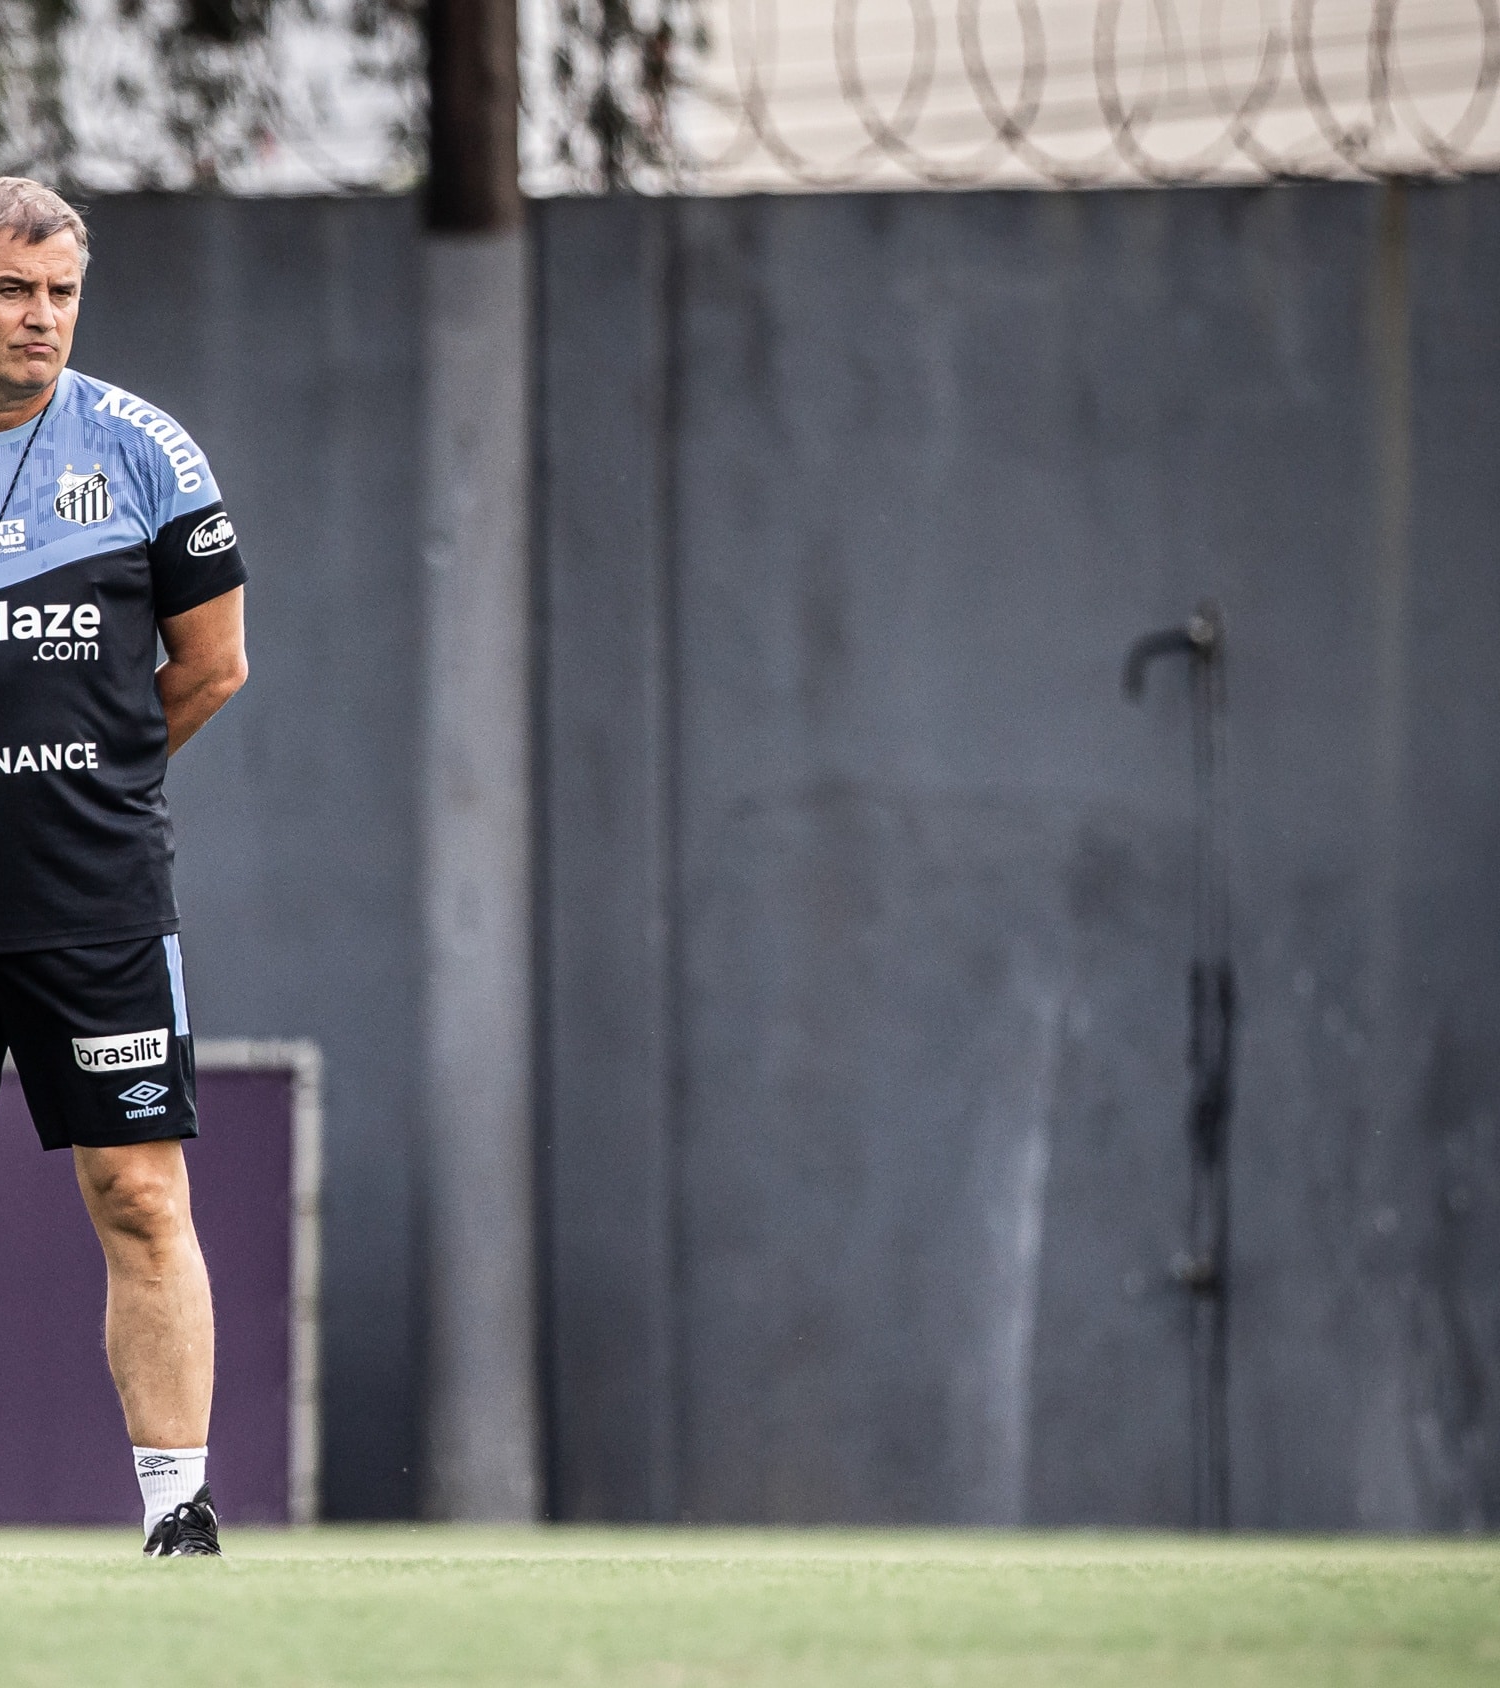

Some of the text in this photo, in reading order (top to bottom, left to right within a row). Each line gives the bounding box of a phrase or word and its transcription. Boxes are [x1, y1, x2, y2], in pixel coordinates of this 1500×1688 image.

[32, 641, 99, 661] .com
[76, 1037, 162, 1066] brasilit
[126, 1105, 166, 1119] umbro
